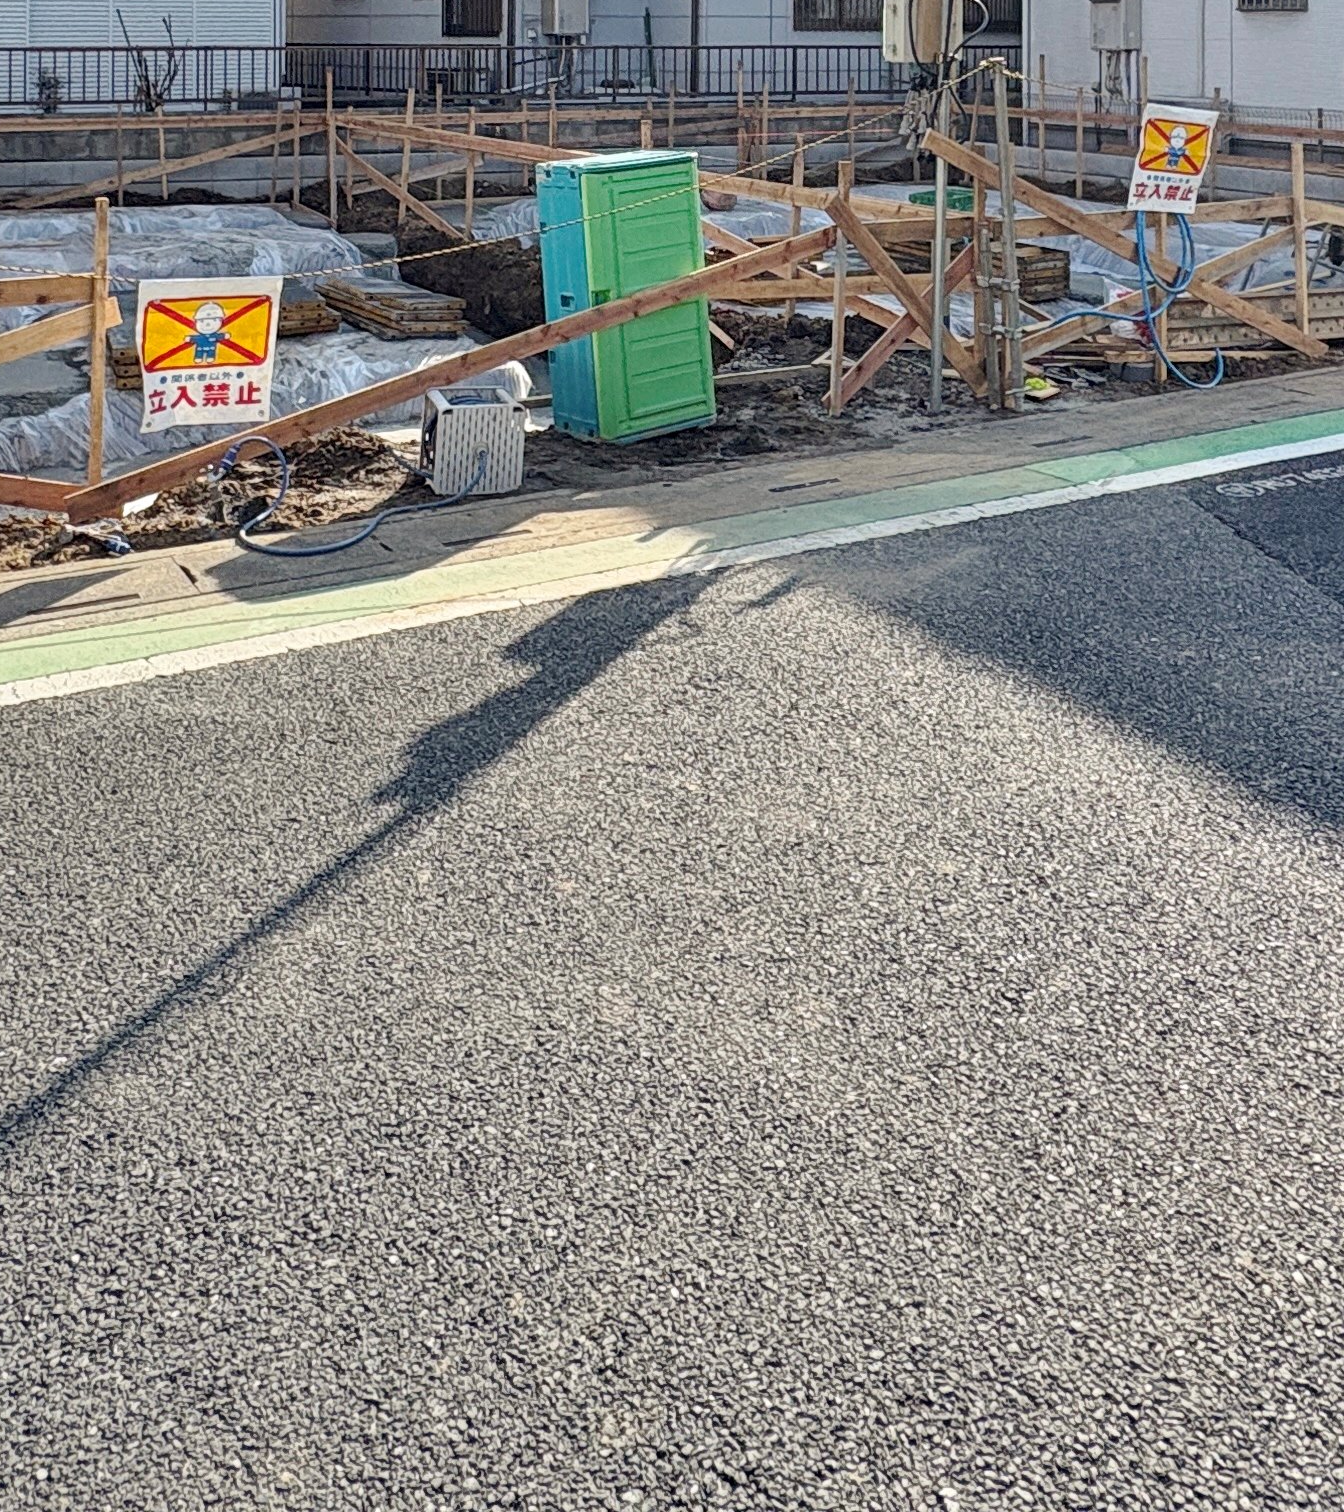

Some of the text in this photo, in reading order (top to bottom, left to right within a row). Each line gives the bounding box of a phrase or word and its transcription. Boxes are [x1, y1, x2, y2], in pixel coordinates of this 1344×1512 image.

[1133, 182, 1194, 201] 立入禁止
[148, 381, 263, 415] 立入禁止
